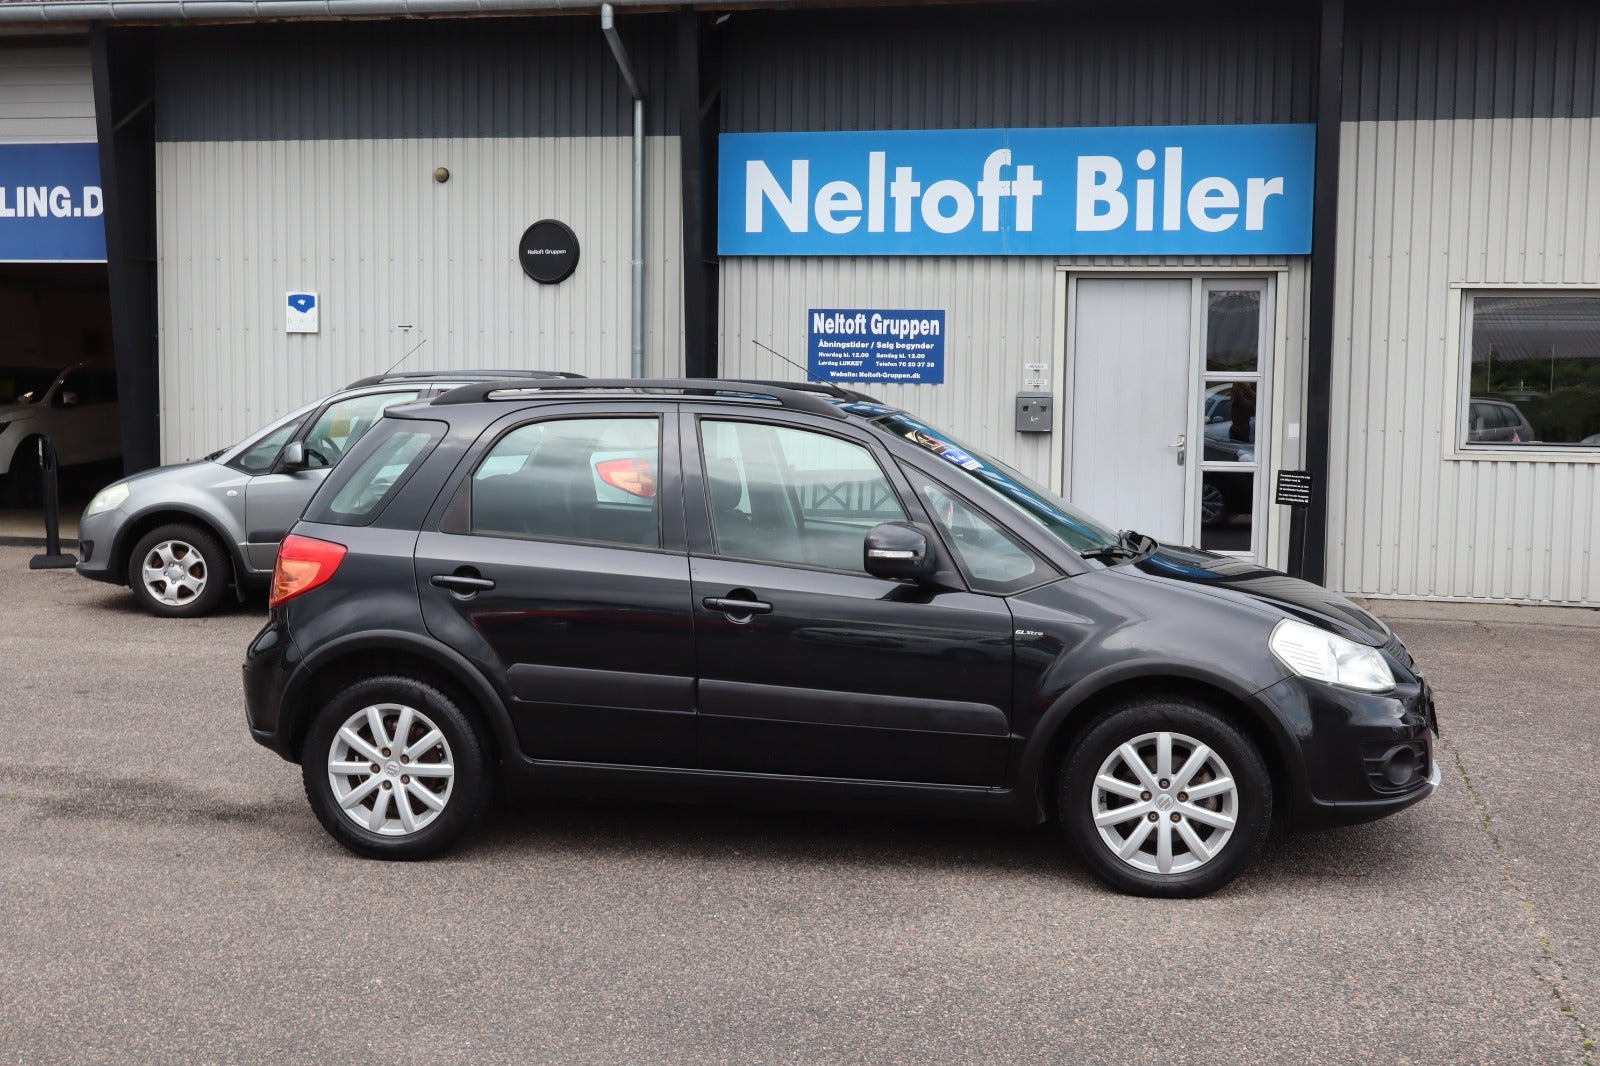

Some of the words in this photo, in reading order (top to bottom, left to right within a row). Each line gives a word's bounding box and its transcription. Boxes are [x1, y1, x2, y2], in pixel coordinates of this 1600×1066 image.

[745, 149, 1042, 234] Neltoft
[1076, 147, 1284, 232] Biler
[814, 313, 866, 334] Neltoft
[871, 314, 939, 339] Gruppen
[818, 339, 869, 350] Åbningstider
[876, 342, 894, 350] Salg
[896, 342, 934, 351] begynder
